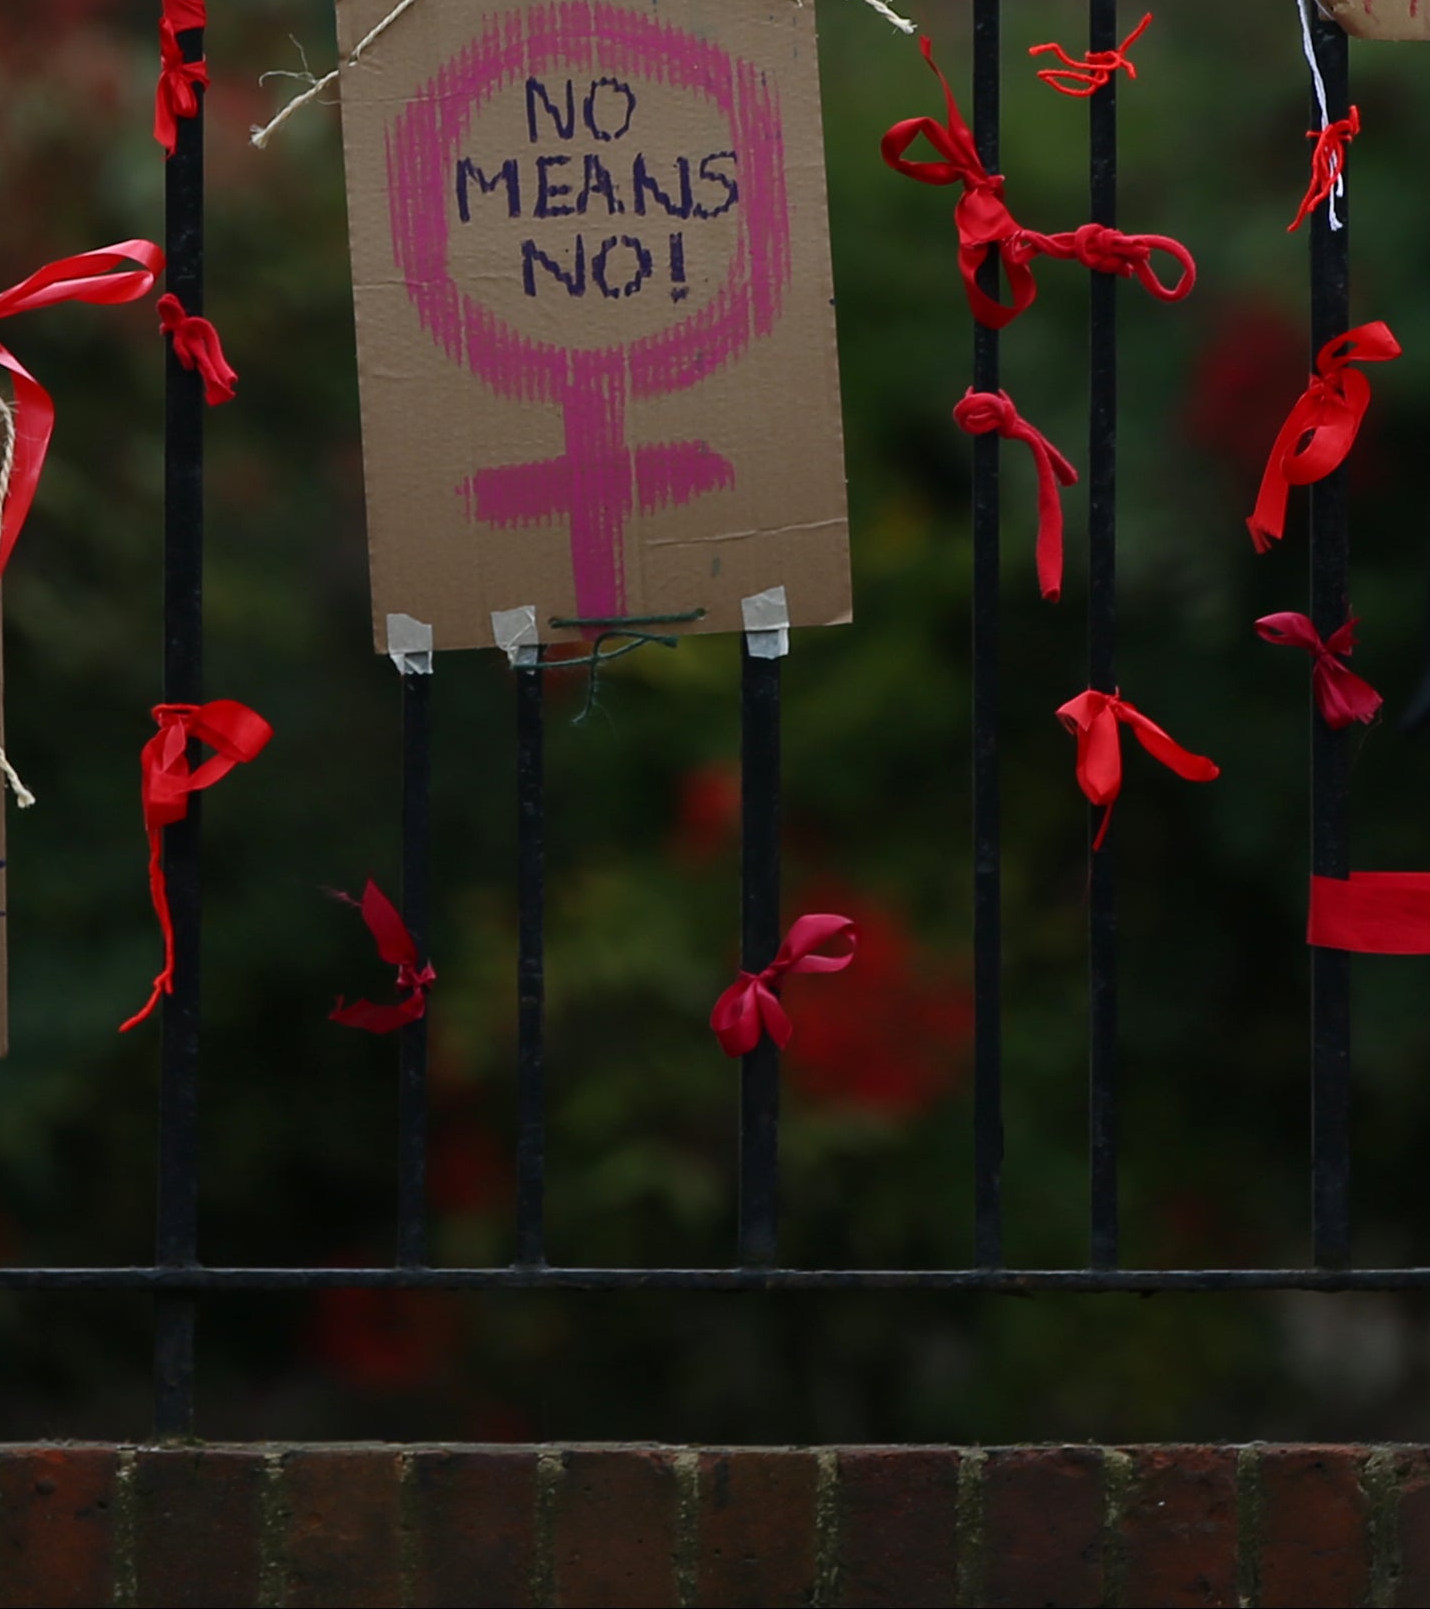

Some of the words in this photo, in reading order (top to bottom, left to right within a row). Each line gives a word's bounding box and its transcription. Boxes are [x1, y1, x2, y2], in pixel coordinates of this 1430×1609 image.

[524, 76, 636, 143] NO
[455, 150, 738, 222] MEANS
[521, 232, 687, 302] NO!
